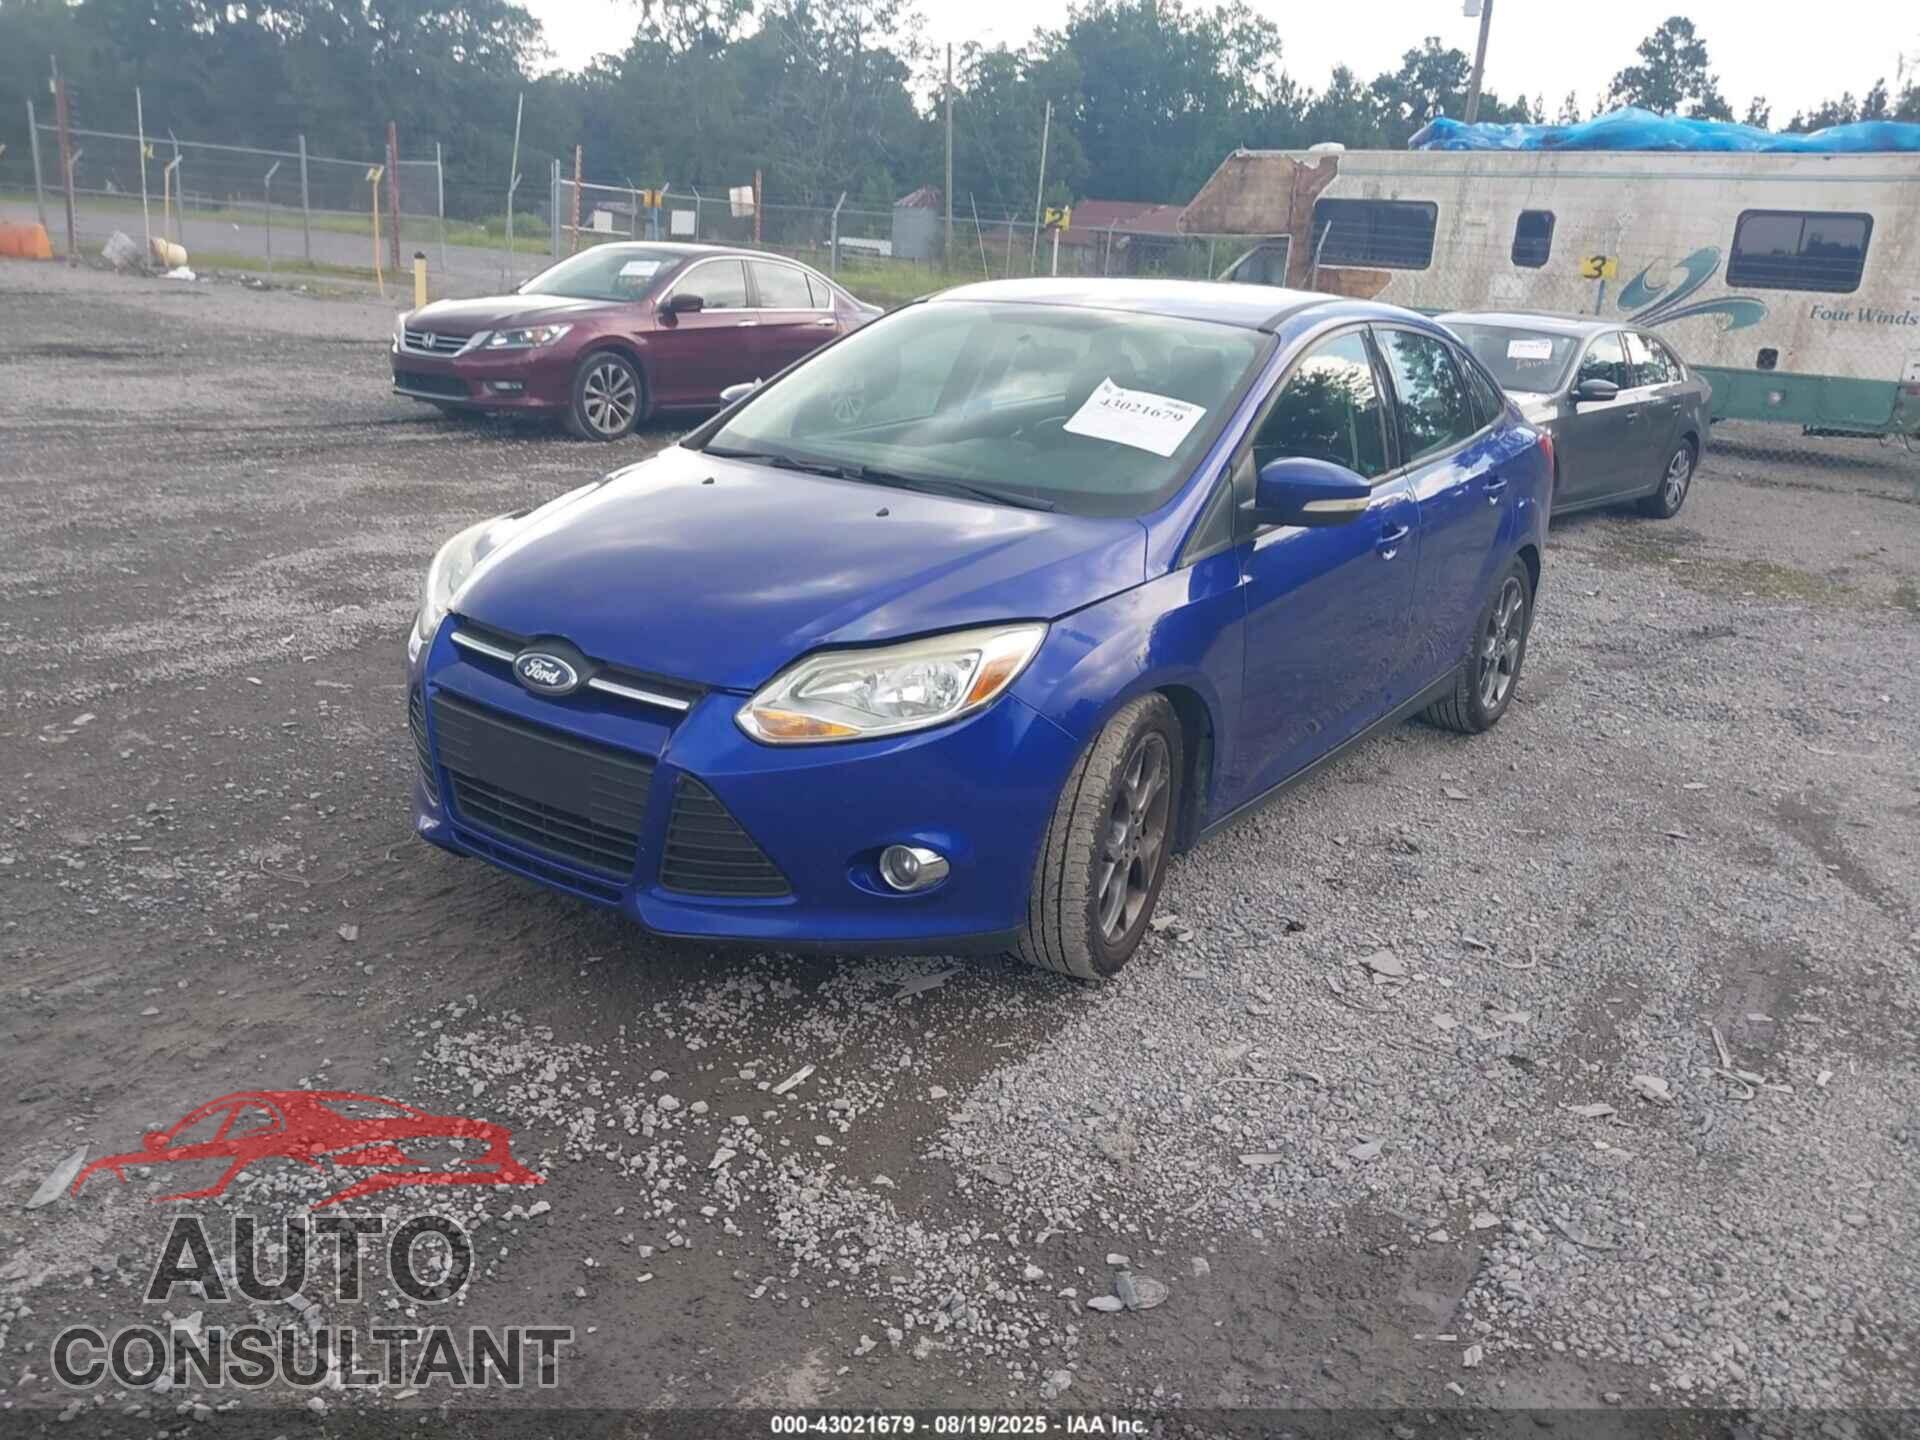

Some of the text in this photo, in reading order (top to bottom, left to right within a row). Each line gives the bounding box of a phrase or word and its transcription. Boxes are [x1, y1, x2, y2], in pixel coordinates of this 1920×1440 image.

[1048, 209, 1064, 229] 2
[1583, 255, 1607, 279] 3
[1810, 304, 1919, 326] Four Winds
[1100, 398, 1184, 422] 43021679
[523, 657, 561, 685] Ford
